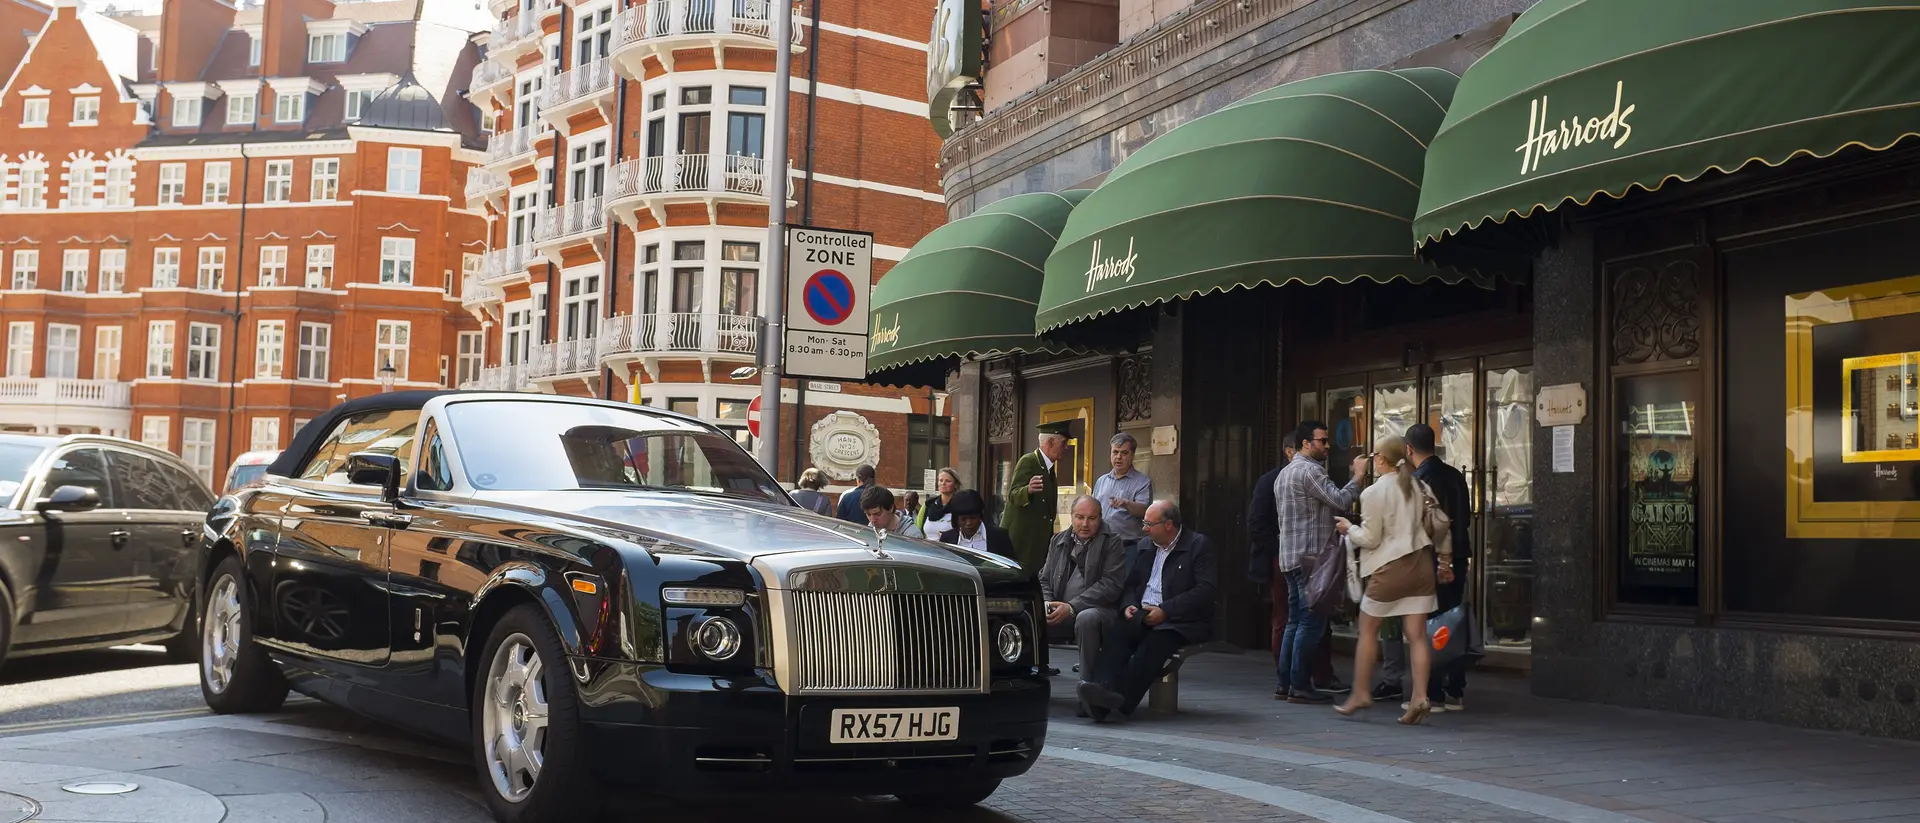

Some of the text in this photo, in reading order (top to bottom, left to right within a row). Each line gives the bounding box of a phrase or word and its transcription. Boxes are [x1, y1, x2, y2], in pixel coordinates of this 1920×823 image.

[1515, 80, 1635, 175] Harrods
[796, 231, 866, 249] Controlled
[806, 248, 855, 266] ZONE
[1084, 236, 1138, 293] Harrods
[870, 312, 901, 353] Harrods
[832, 337, 847, 346] Sat
[789, 345, 810, 354] 8.30
[829, 347, 850, 357] 6.30
[850, 350, 864, 359] pm
[823, 383, 840, 391] STREET
[837, 436, 857, 444] HANS
[834, 448, 860, 456] CRESCENT
[1873, 463, 1898, 478] Harrods
[1634, 557, 1641, 565] IN
[1642, 557, 1671, 566] CINEMAS
[1672, 558, 1686, 567] MAY
[840, 712, 951, 739] RX57 HJG
